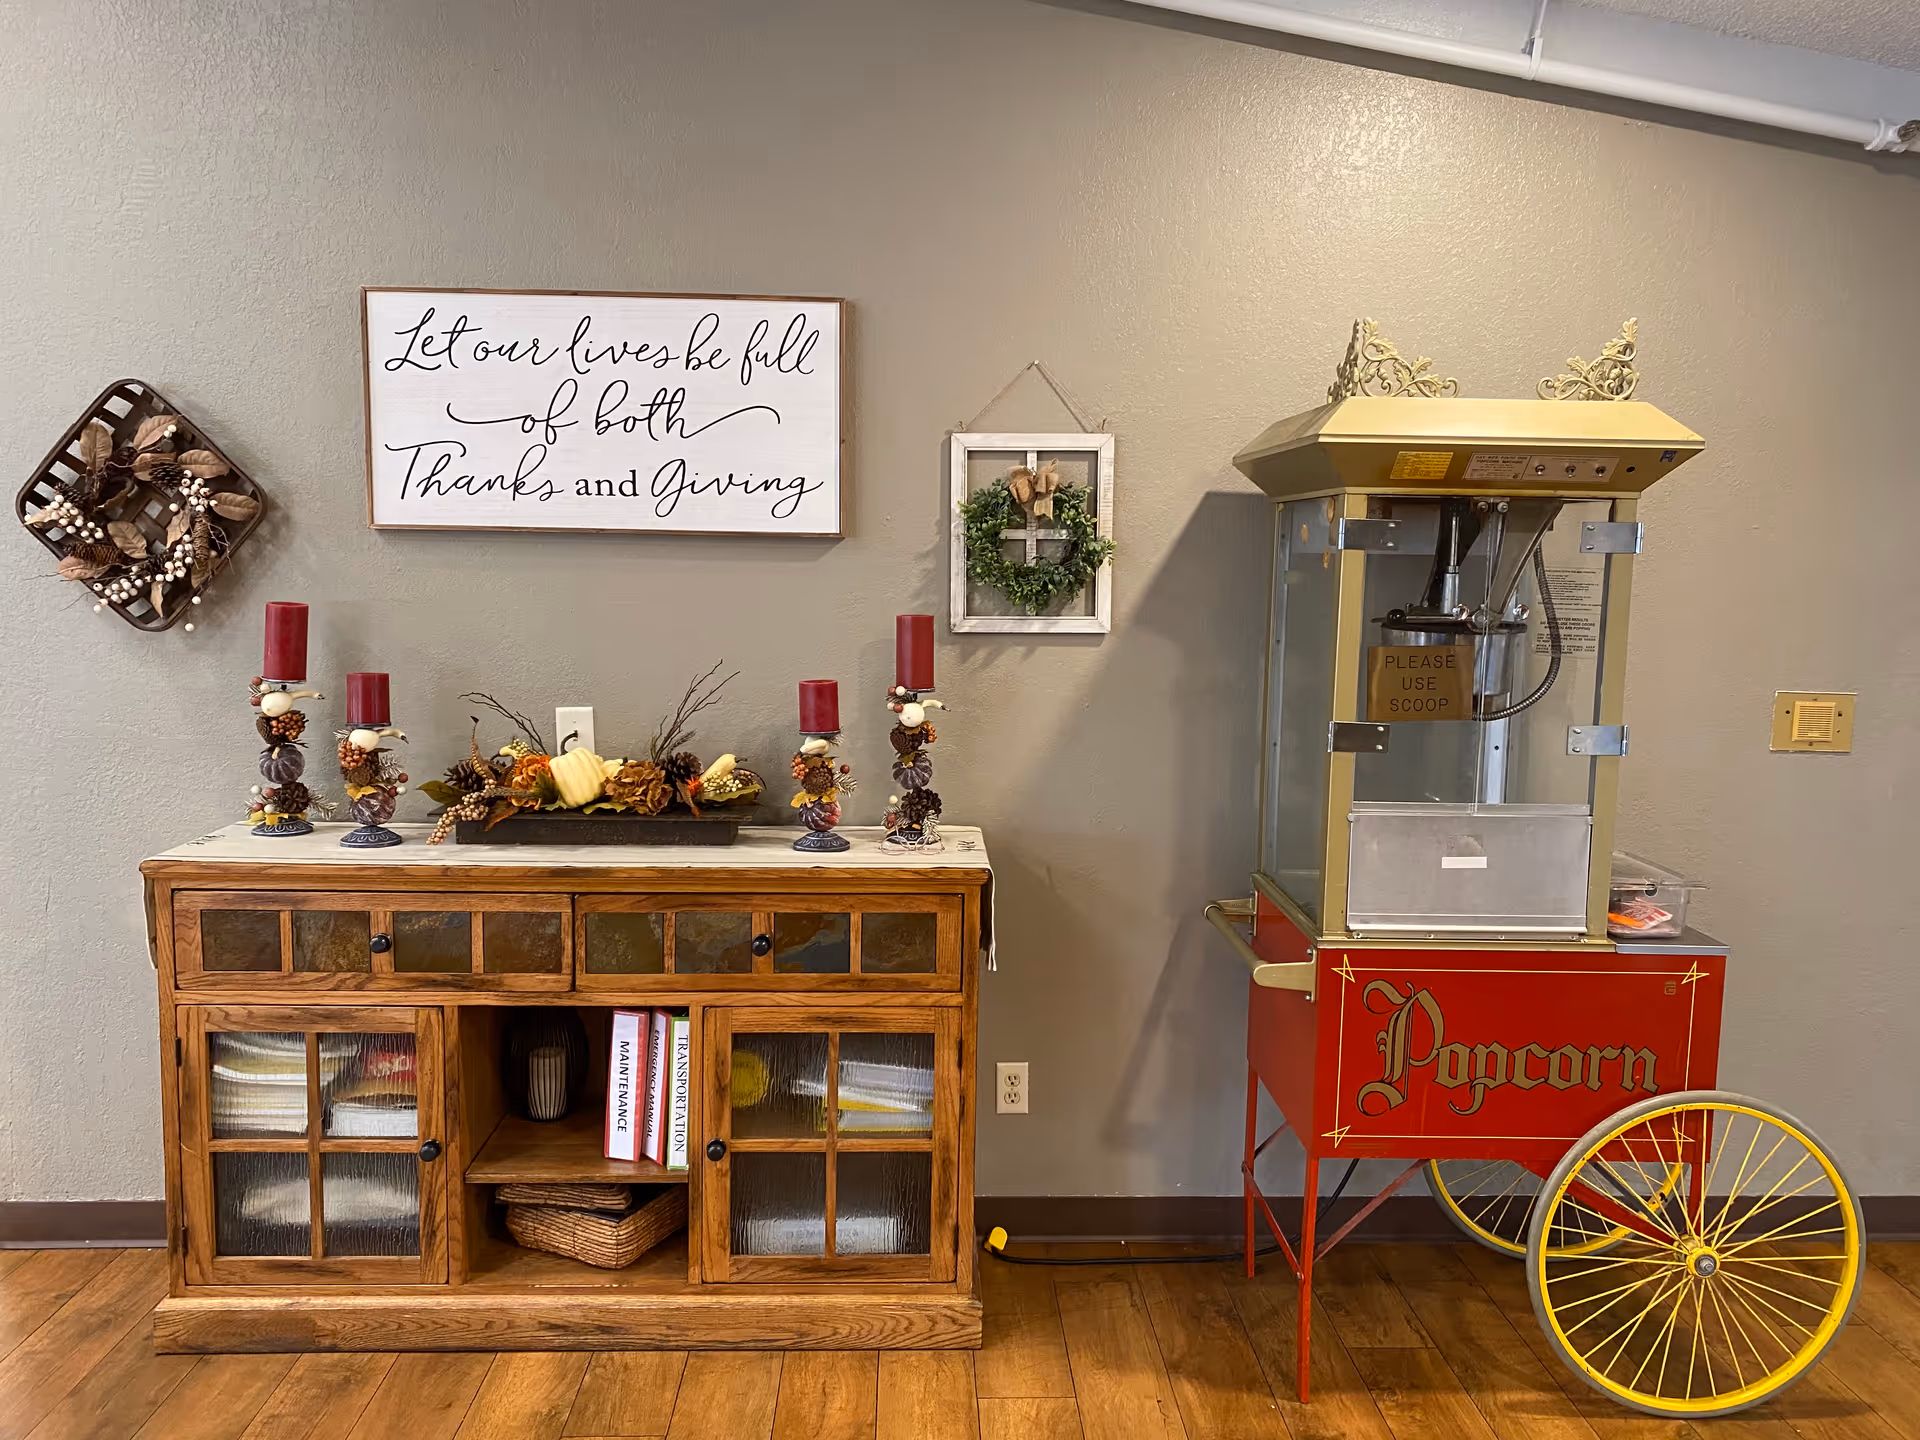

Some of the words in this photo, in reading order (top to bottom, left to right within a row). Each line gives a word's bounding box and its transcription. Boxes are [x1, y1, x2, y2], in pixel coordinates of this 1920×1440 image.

[385, 308, 482, 371] Let
[474, 336, 559, 365] our
[566, 315, 679, 375] lives
[686, 312, 731, 371] be
[741, 313, 820, 386] full
[385, 441, 564, 502] Thanks
[575, 470, 640, 498] and
[651, 458, 824, 519] Giving
[1385, 655, 1456, 669] PLEASE
[1402, 677, 1437, 691] USE
[1390, 698, 1449, 712] SCOOP
[650, 1029, 660, 1091] EMERGENCY
[1357, 979, 1659, 1116] Popcorn
[617, 1041, 630, 1132] MAINTENANCE
[646, 1093, 656, 1138] MANUAL
[674, 1035, 688, 1152] TRANSPORTATION
